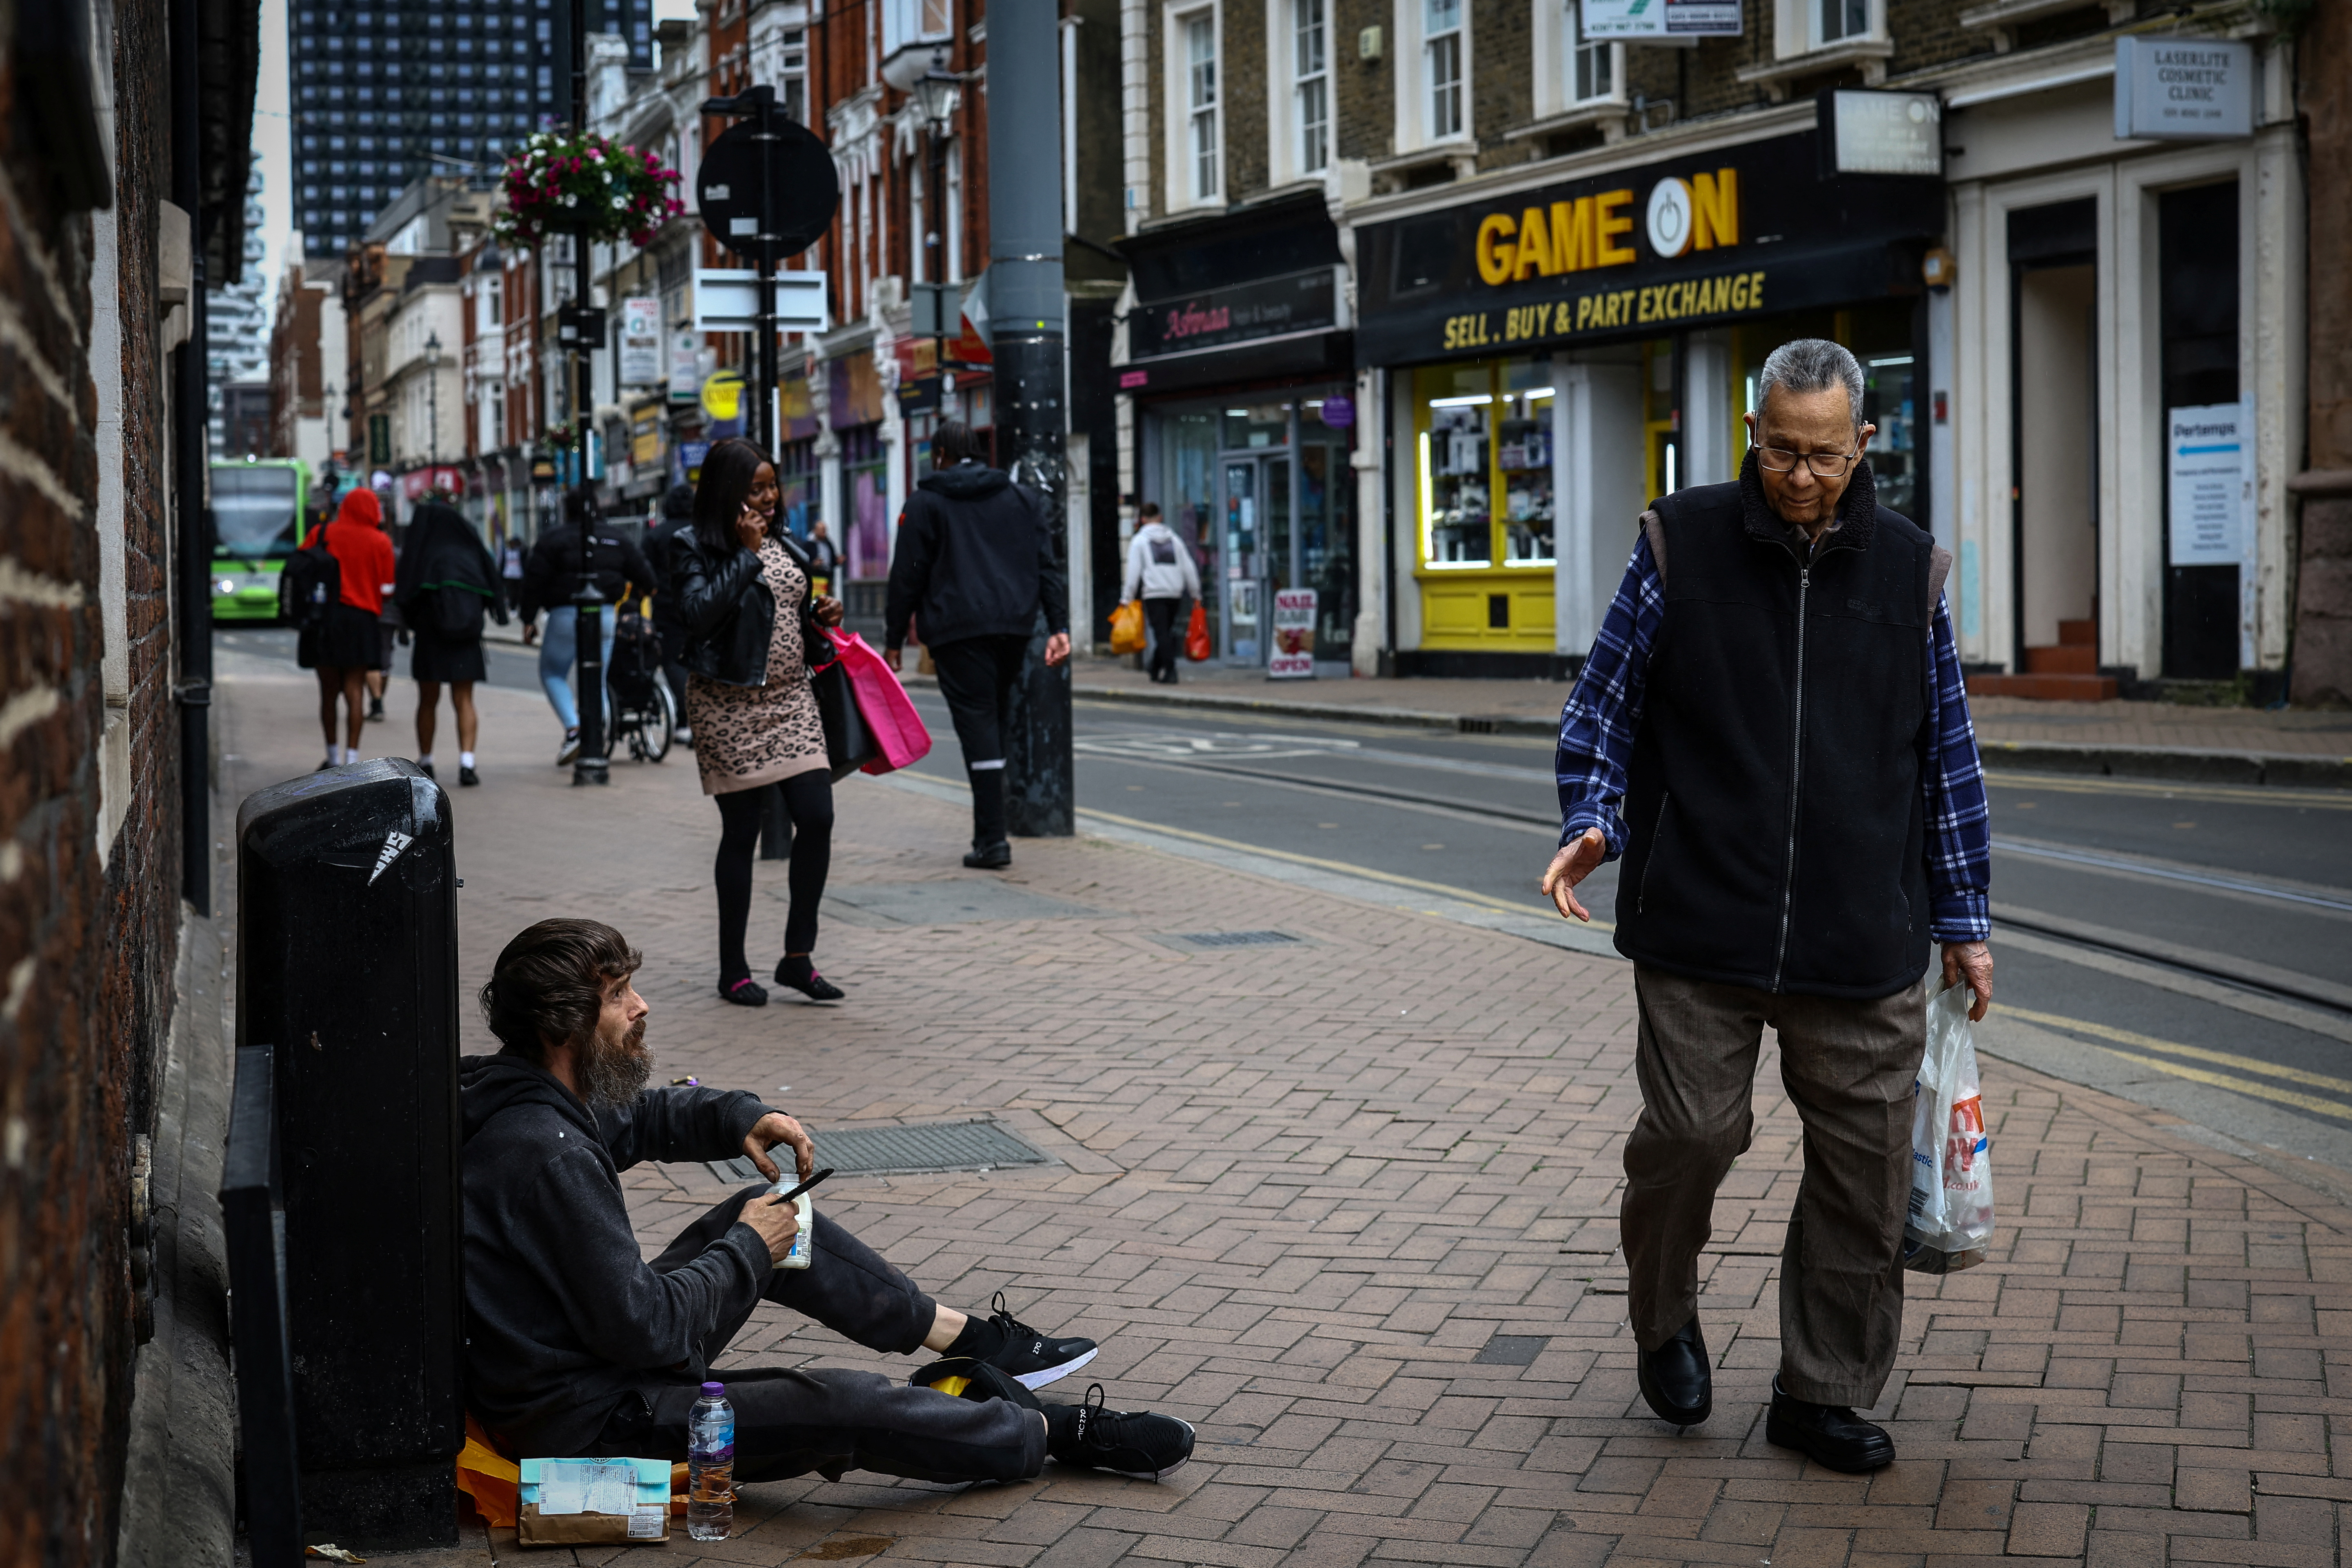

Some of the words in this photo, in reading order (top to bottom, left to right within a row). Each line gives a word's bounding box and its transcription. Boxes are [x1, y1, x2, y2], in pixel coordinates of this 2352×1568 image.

[2154, 50, 2230, 68] LASERLITE
[2158, 67, 2227, 85] COSMETIC
[2168, 84, 2215, 102] CLINIC
[1476, 188, 1637, 286] GAME
[1505, 302, 1552, 341] BUY
[1553, 300, 1572, 334] &
[1576, 289, 1636, 331] PART
[1637, 271, 1766, 324] EXCHANGE
[1276, 594, 1317, 610] NAIL
[1270, 658, 1311, 672] OPEN
[1033, 1342, 1042, 1355] 270
